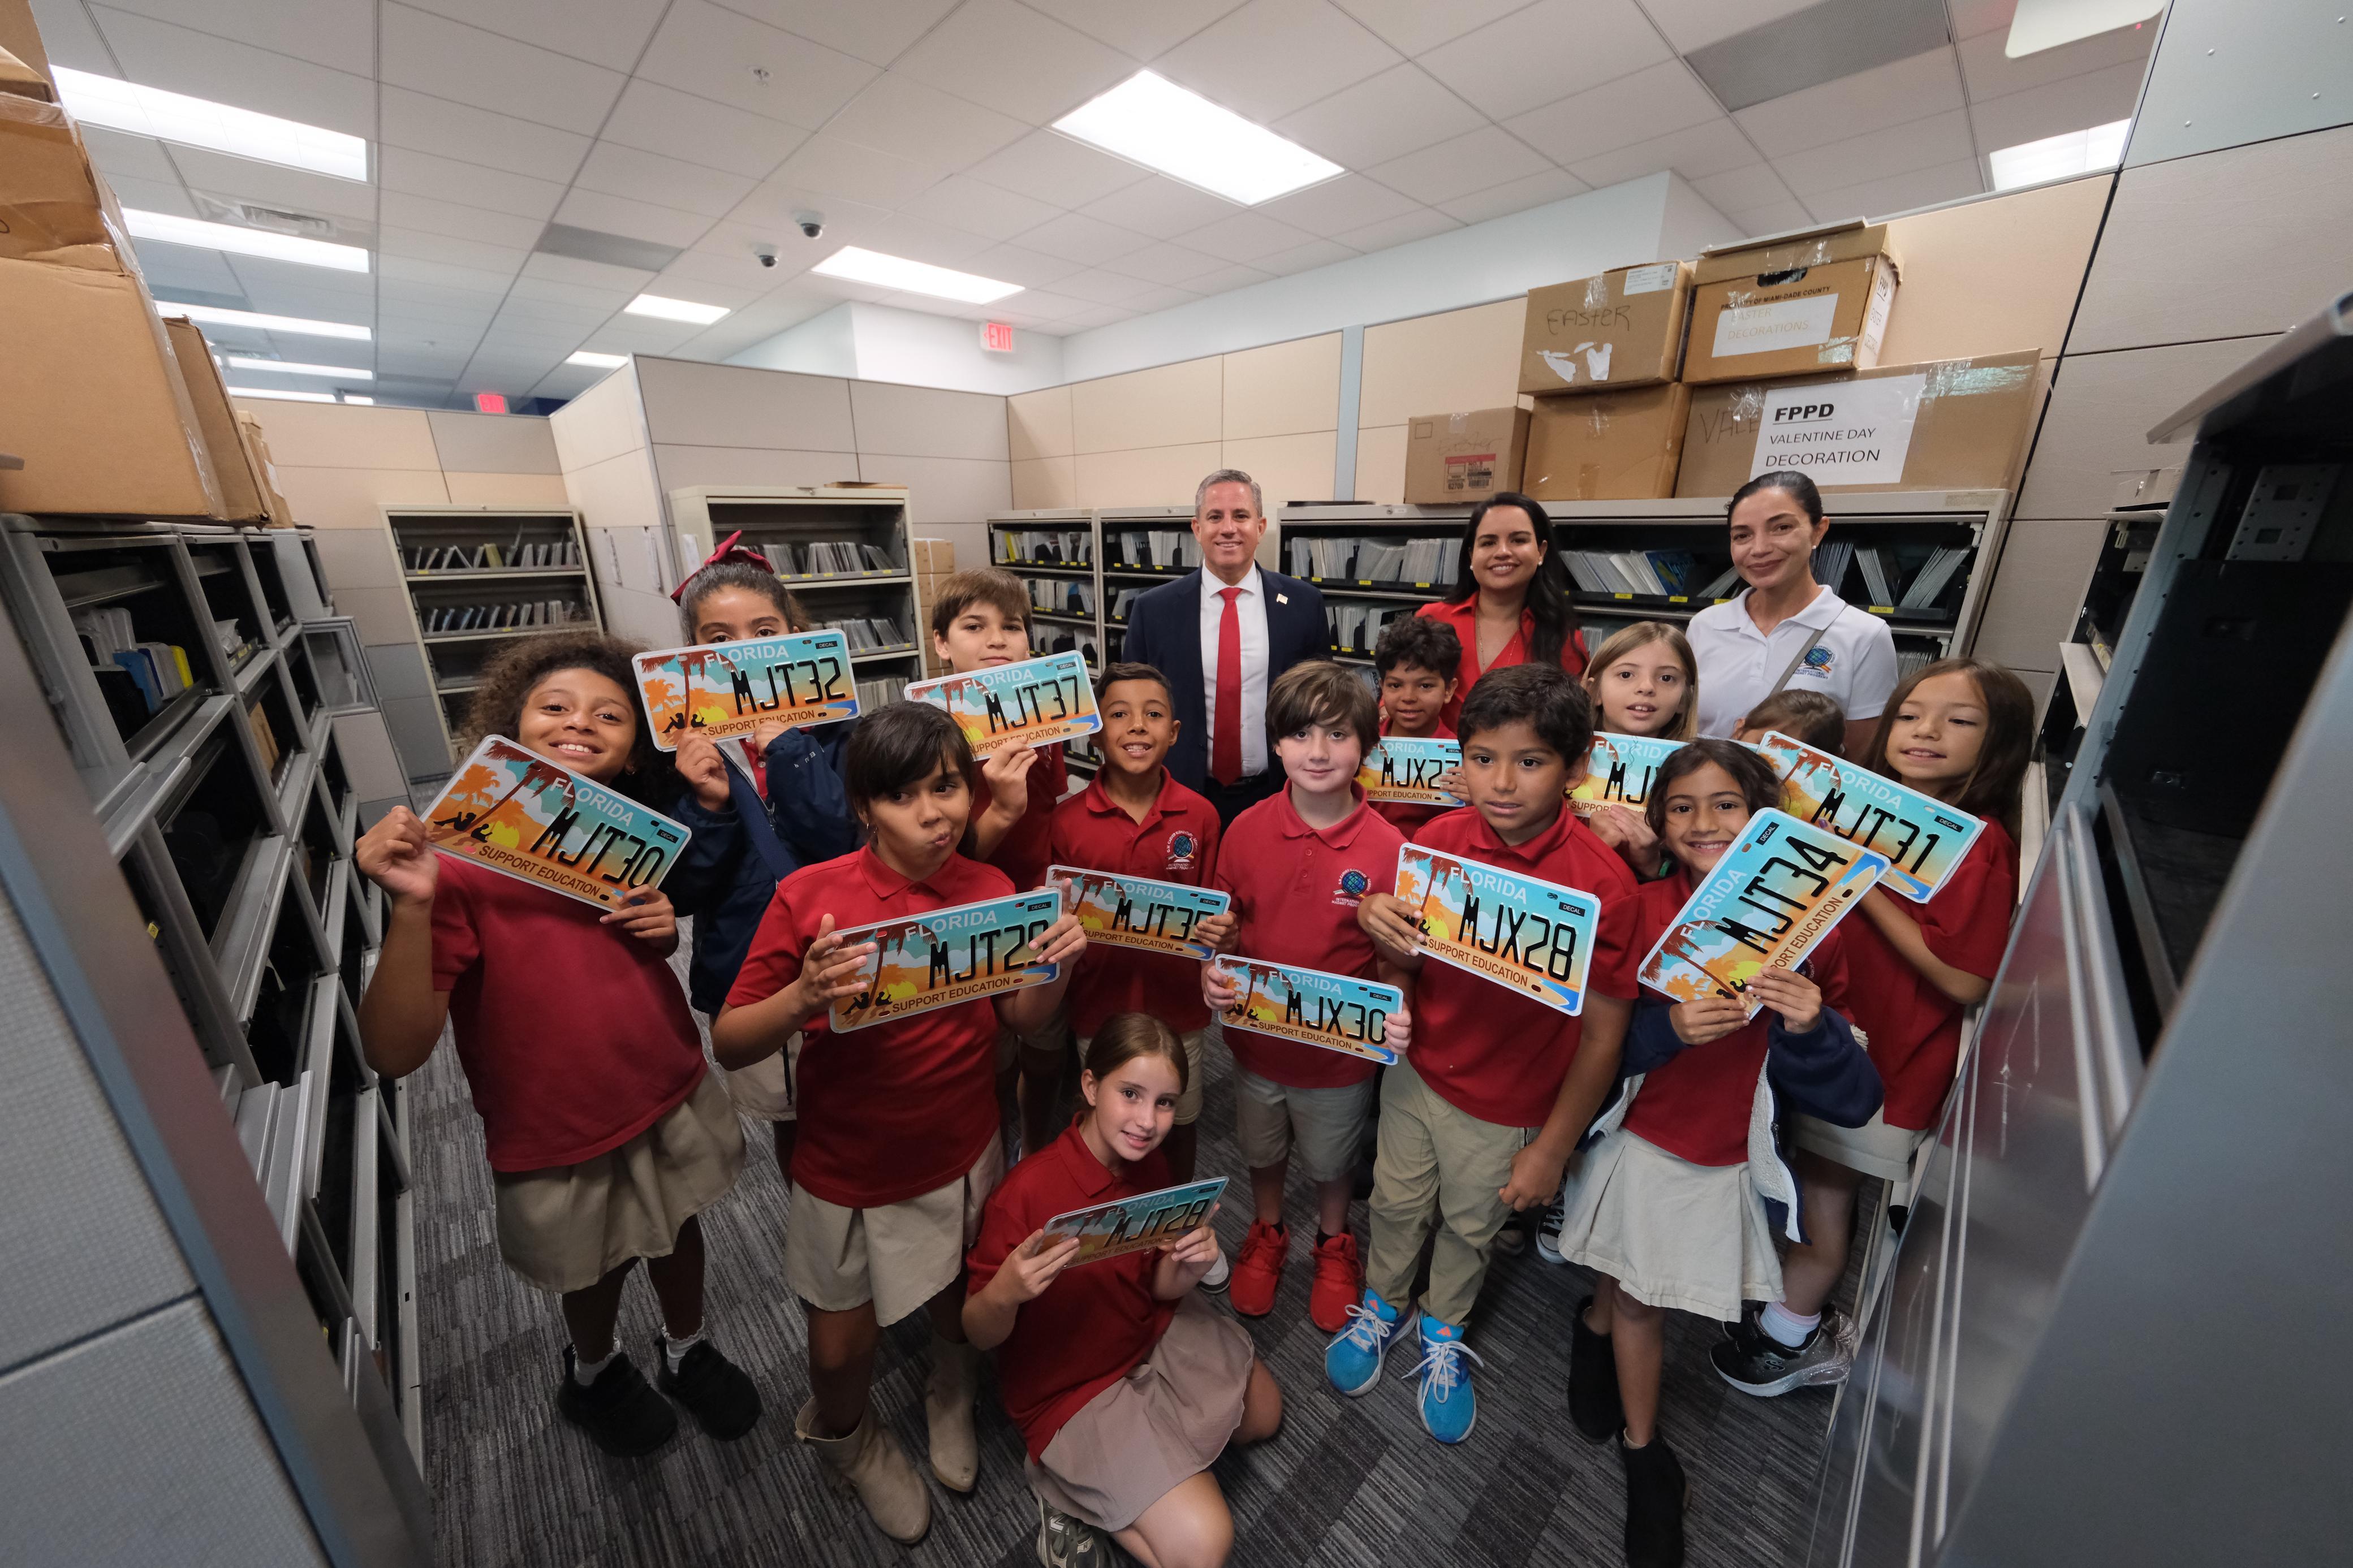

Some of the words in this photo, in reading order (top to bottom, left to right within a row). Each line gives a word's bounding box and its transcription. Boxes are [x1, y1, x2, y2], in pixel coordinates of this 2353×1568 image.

[1721, 298, 1753, 310] PROTY
[1754, 296, 1763, 305] OF
[1764, 291, 1802, 302] MIAMI-DADE
[1803, 286, 1831, 296] COUNTY
[1731, 307, 1772, 322] EASTER
[987, 323, 1012, 351] EXIT
[1728, 320, 1810, 340] DECORATIONS
[1774, 403, 1834, 422] FPPD
[1770, 429, 1845, 445] VALENTINE
[1847, 427, 1877, 440] DAY
[1765, 448, 1880, 467] DECORATION
[704, 645, 790, 668] FLORIDA
[731, 656, 846, 715] MJT32
[961, 668, 1034, 693] FLORIDA
[985, 675, 1080, 733] MJT37
[708, 719, 756, 736] SUPPORT
[1373, 742, 1425, 755] LORIDA
[1393, 791, 1432, 800] EDUCATION
[1817, 761, 1902, 810] FLORIDA
[550, 777, 634, 827] FLORIDA
[1571, 800, 1611, 813] SUPPOR
[659, 831, 676, 842] DECAL
[1760, 824, 1777, 843] DECAL
[1811, 788, 1941, 874] MJT31
[1939, 818, 1959, 831] DECAL
[529, 806, 665, 889] MJT30
[479, 845, 538, 874] SUPPORT
[536, 866, 600, 897] EDUCATION
[1104, 880, 1175, 902] FLORIDA
[1450, 867, 1527, 904] FLORIDA
[1715, 836, 1848, 955] MJT34
[1562, 904, 1581, 915] DECAL
[1680, 868, 1748, 941] FLORIDA
[905, 909, 998, 942] FLORIDA
[1790, 897, 1843, 949] EDUCATION
[1083, 930, 1123, 943] SUPPORT
[1125, 935, 1174, 951] EDUCATION
[1458, 894, 1577, 983] MJX28
[1428, 938, 1471, 964] SUPPORT
[1472, 952, 1528, 987] EDUCATION
[892, 992, 946, 1013] SUPPORT
[949, 977, 1011, 999] EDUCATION
[1269, 970, 1342, 996] FLORIDA
[1258, 1021, 1299, 1037] SUPPORT
[1301, 1031, 1352, 1049] EDUCATION
[1105, 1194, 1176, 1219] FLORIDA
[1104, 1198, 1210, 1248] MJT28
[1070, 1250, 1111, 1265] SUPPORT
[1115, 1237, 1164, 1253] EDUCATION
